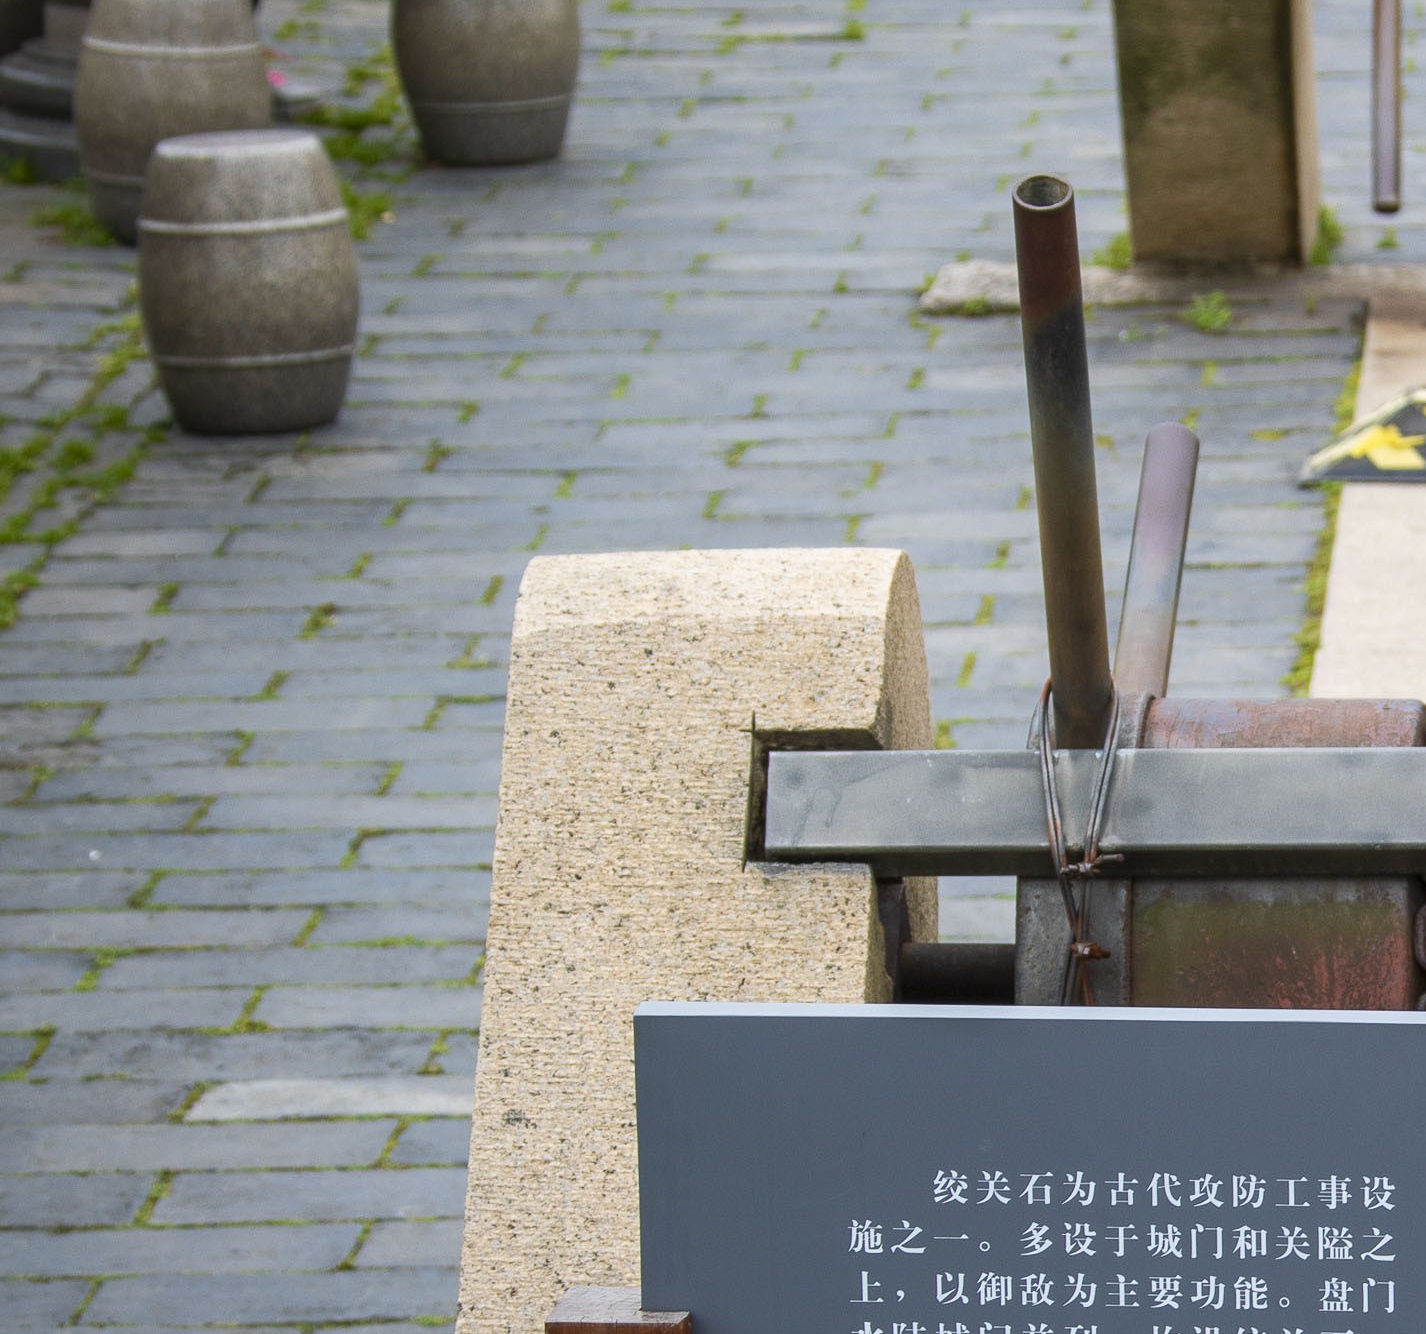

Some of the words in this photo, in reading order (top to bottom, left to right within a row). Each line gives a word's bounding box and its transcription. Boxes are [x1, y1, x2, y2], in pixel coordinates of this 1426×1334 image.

[933, 1169, 1396, 1211] 绞关石为古代攻防工事设
[847, 1219, 1397, 1262] 施之一。多设于城门和关隘之
[849, 1270, 1395, 1314] 上，以御敌为主要功能。盘门
